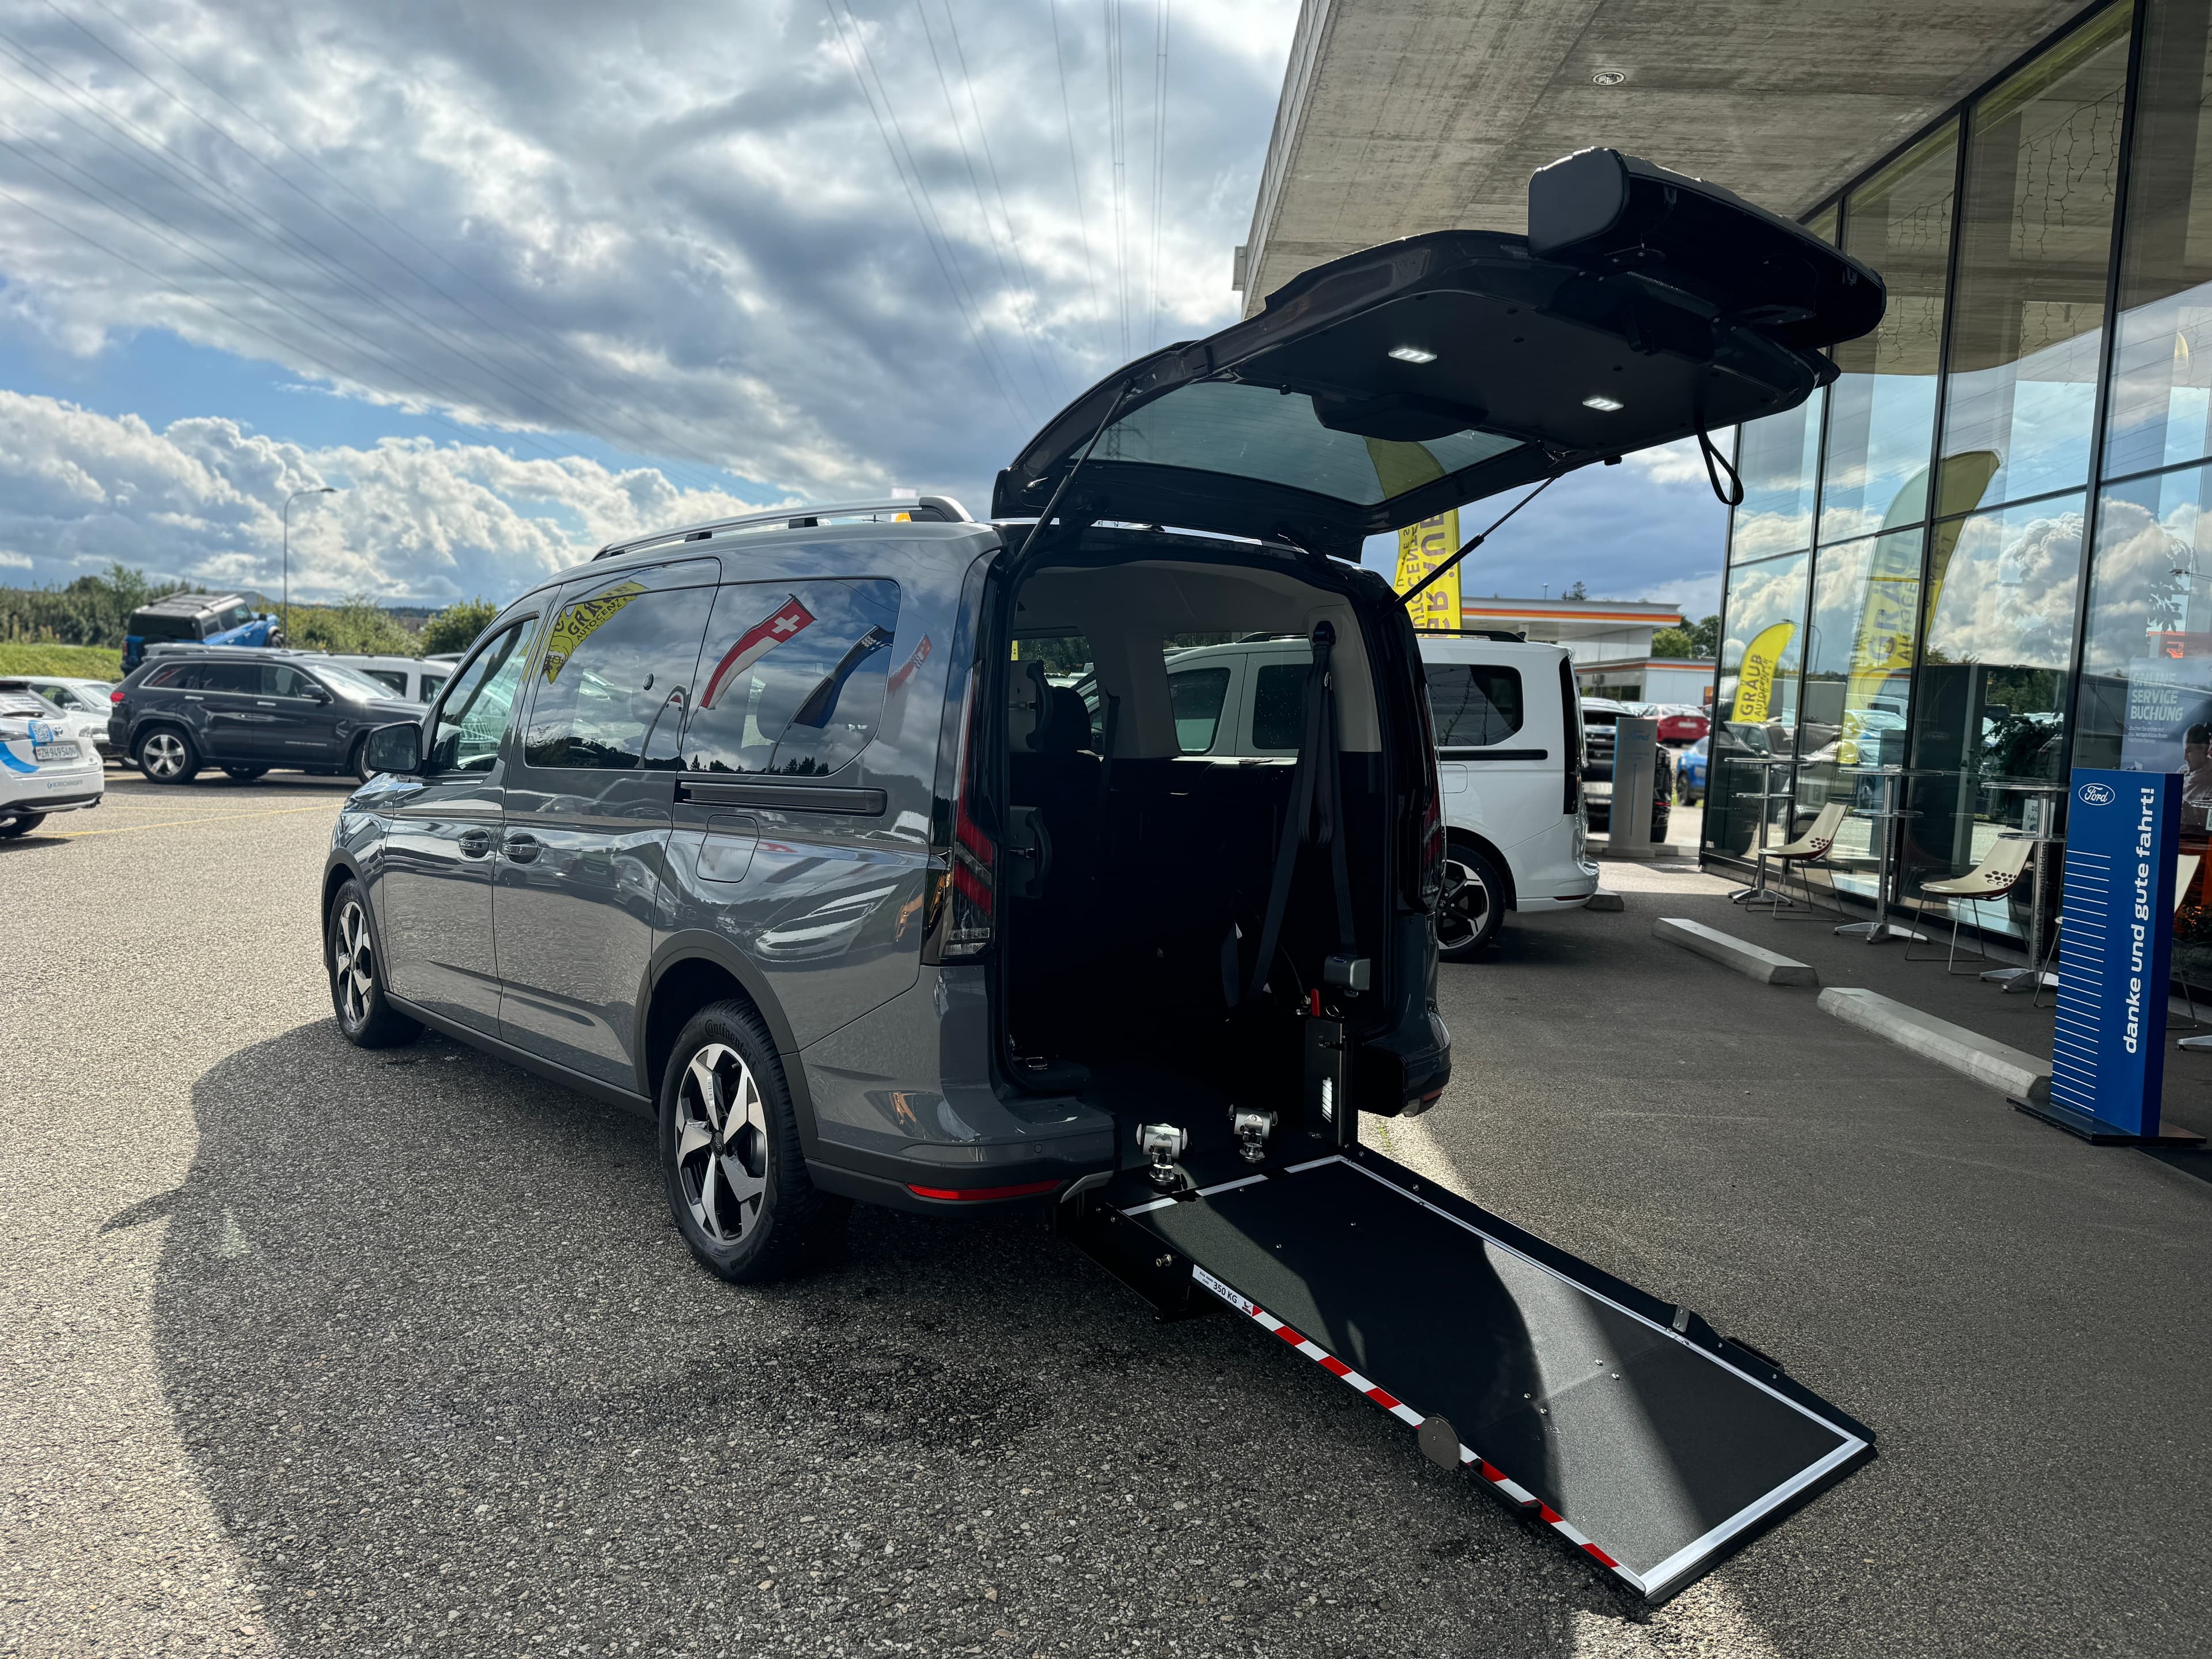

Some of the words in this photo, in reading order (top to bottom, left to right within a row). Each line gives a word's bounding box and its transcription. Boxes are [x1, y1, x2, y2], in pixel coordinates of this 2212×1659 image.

[2130, 705, 2184, 721] BUCHUNG
[2131, 689, 2179, 704] SERVICE
[2084, 785, 2109, 803] Ford
[2136, 787, 2155, 858] fahrt!
[2134, 863, 2149, 922] gute
[2131, 923, 2145, 972] und
[2123, 977, 2141, 1054] danke
[705, 1018, 752, 1066] Continental
[1213, 1281, 1226, 1296] 350
[1228, 1291, 1238, 1304] KG
